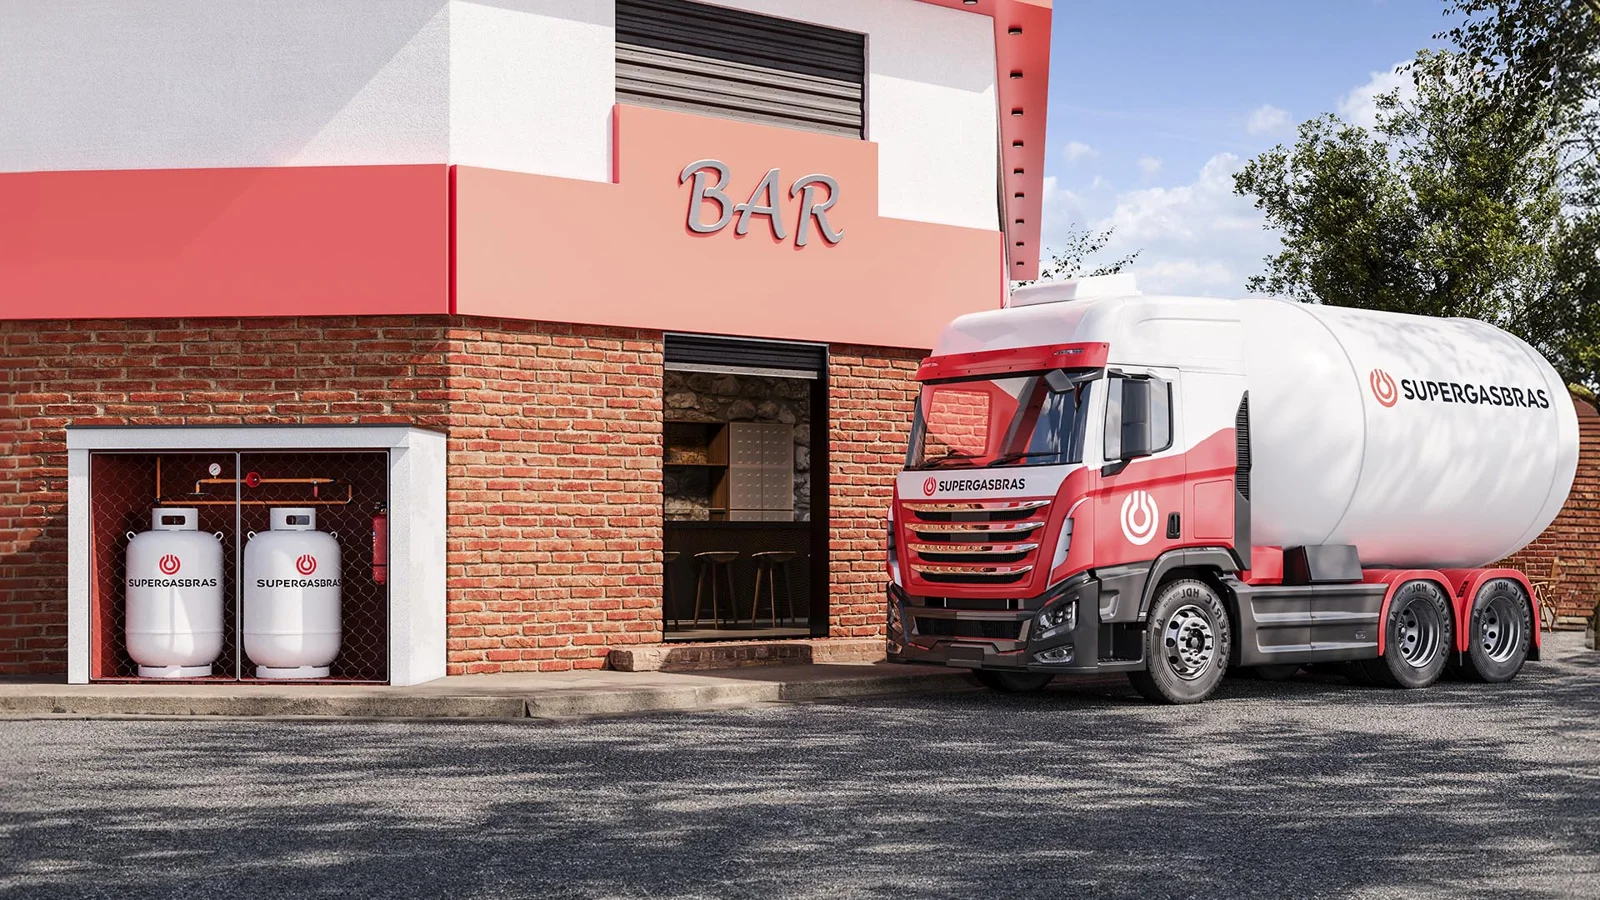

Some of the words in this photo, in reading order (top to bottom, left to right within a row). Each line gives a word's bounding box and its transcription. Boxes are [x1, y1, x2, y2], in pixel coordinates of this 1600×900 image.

[679, 158, 844, 247] BAR
[1400, 378, 1550, 409] SUPERGASBRAS
[938, 478, 1026, 492] SUPERGASBRAS
[128, 578, 217, 588] SUPERGASBRAS
